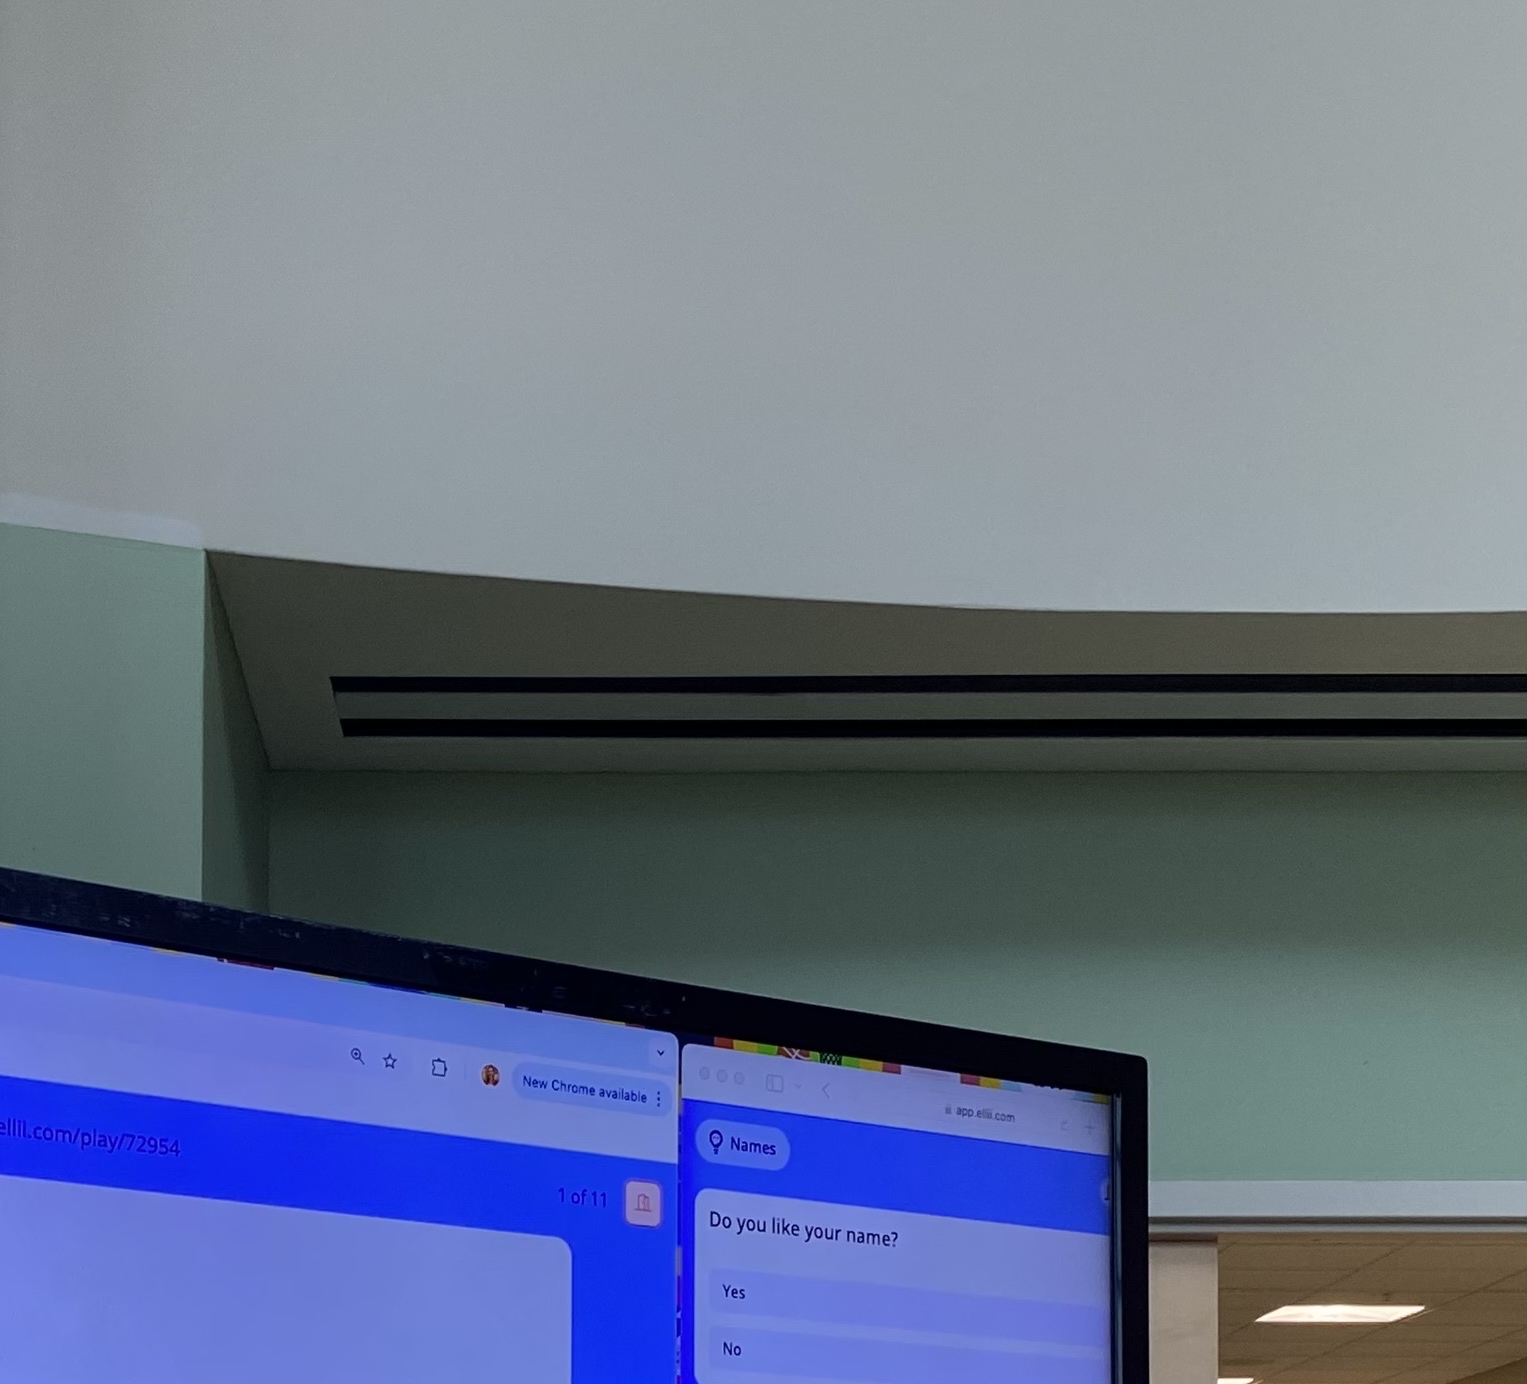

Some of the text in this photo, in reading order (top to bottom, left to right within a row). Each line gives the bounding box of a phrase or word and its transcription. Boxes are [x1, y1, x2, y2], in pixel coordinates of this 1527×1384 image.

[522, 1074, 647, 1104] New Chrome available
[729, 1135, 777, 1157] Names
[558, 1187, 607, 1208] 1 of 11
[708, 1210, 899, 1249] Do you like your name?
[722, 1283, 746, 1301] Yes
[722, 1341, 742, 1358] No
